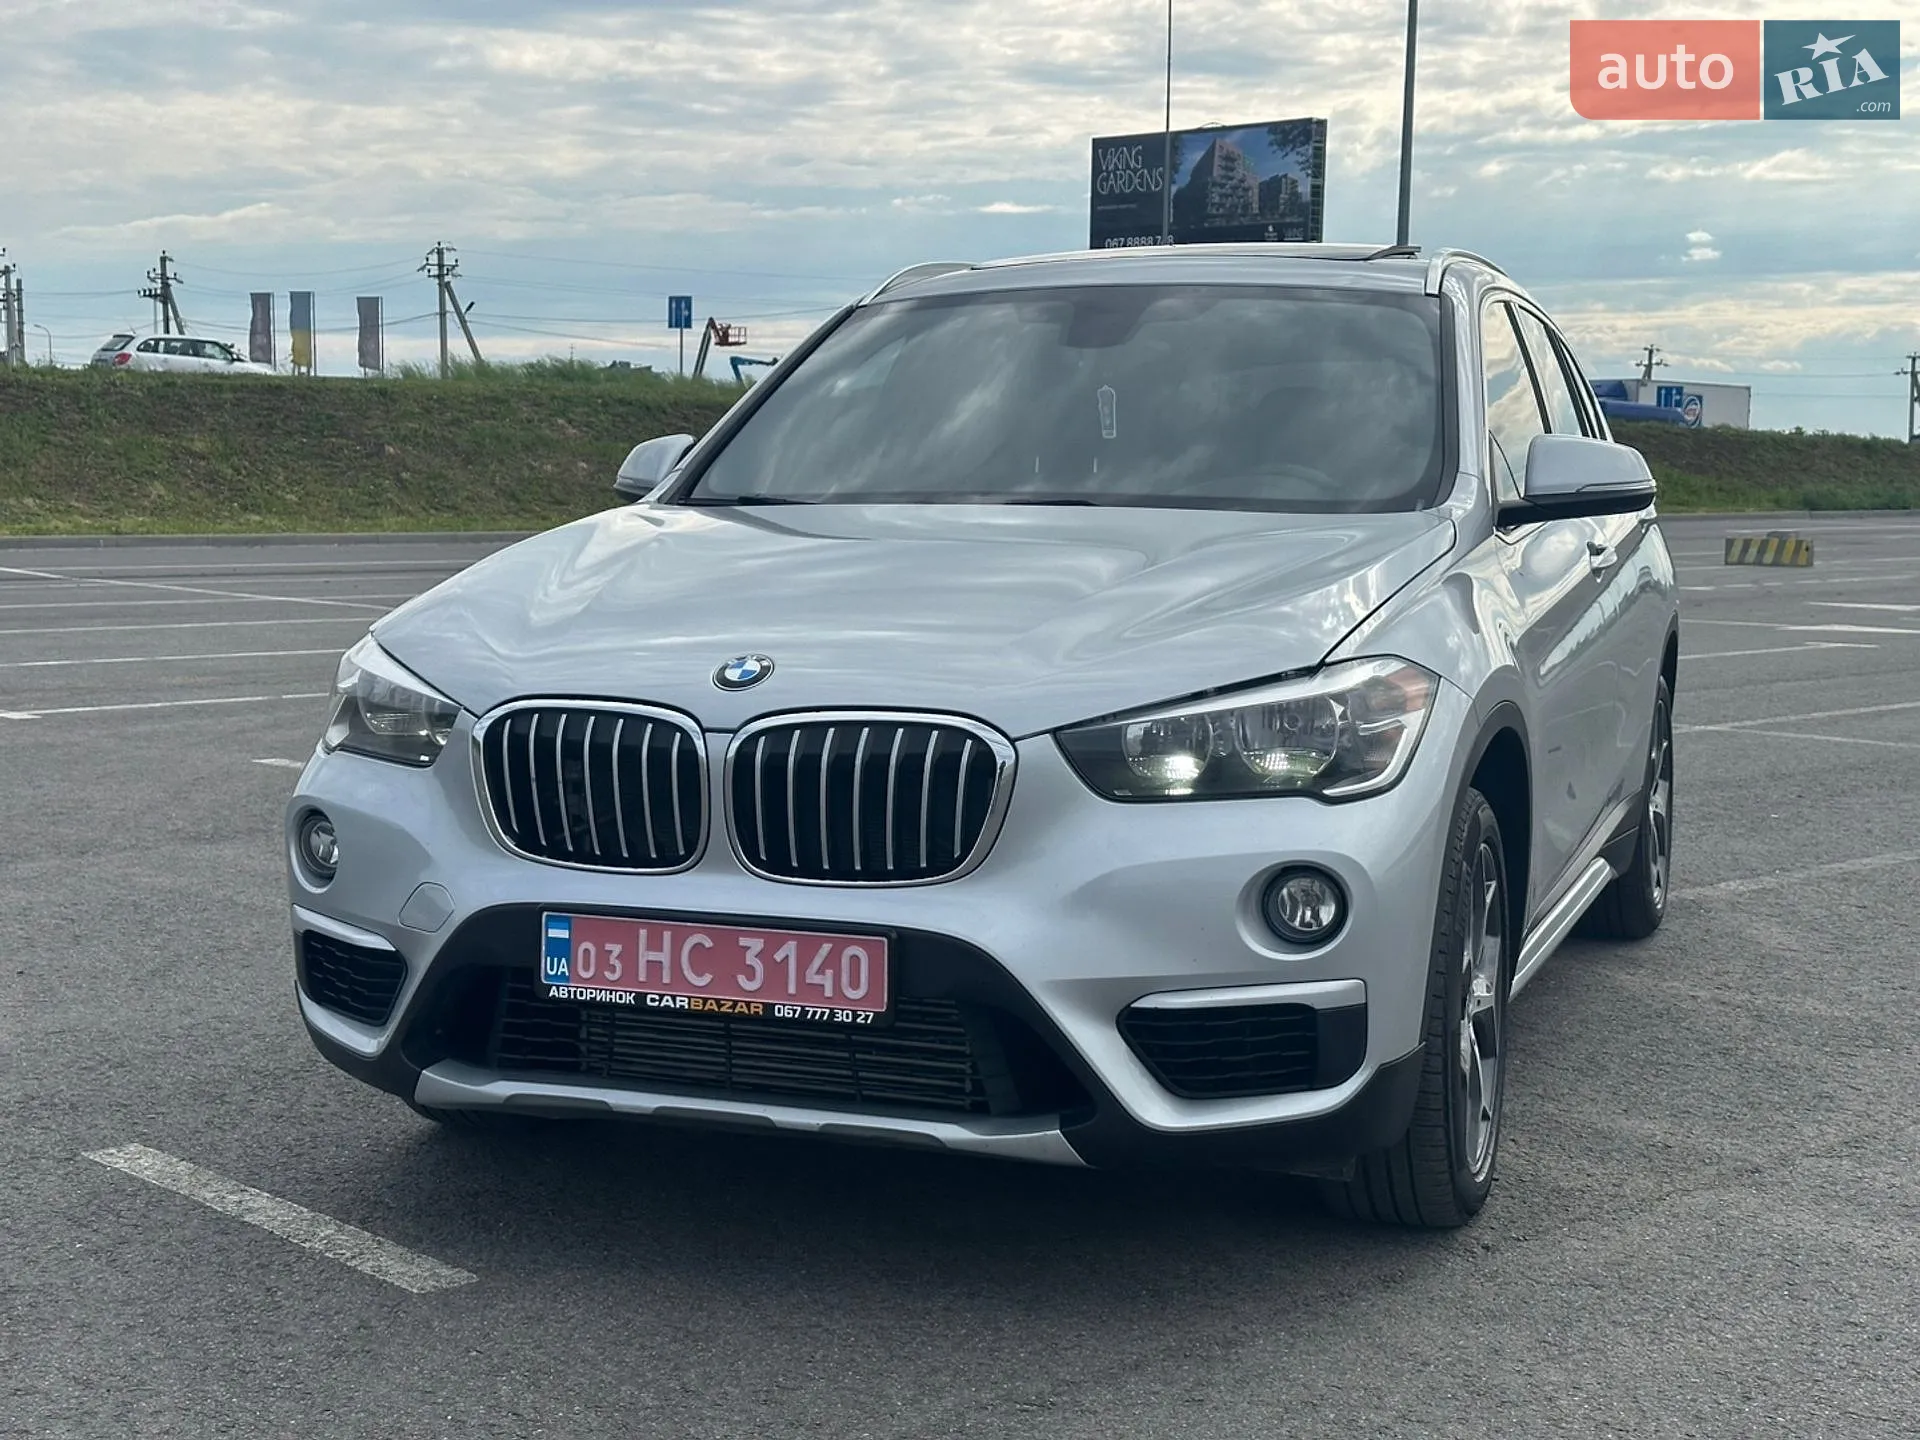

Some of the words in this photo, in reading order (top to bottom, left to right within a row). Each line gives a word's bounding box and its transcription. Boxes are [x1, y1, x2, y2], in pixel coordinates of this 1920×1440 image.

[1097, 167, 1163, 195] GARDENS
[546, 956, 569, 977] UA
[577, 941, 623, 981] 03
[638, 928, 715, 988] HC
[737, 936, 870, 1000] 3140
[549, 985, 635, 1005] АВТОРИНОК
[646, 993, 763, 1016] CARBAZAR
[774, 1004, 801, 1019] 067
[805, 1006, 829, 1022] 777
[834, 1008, 853, 1023] 30
[856, 1010, 874, 1024] 27
